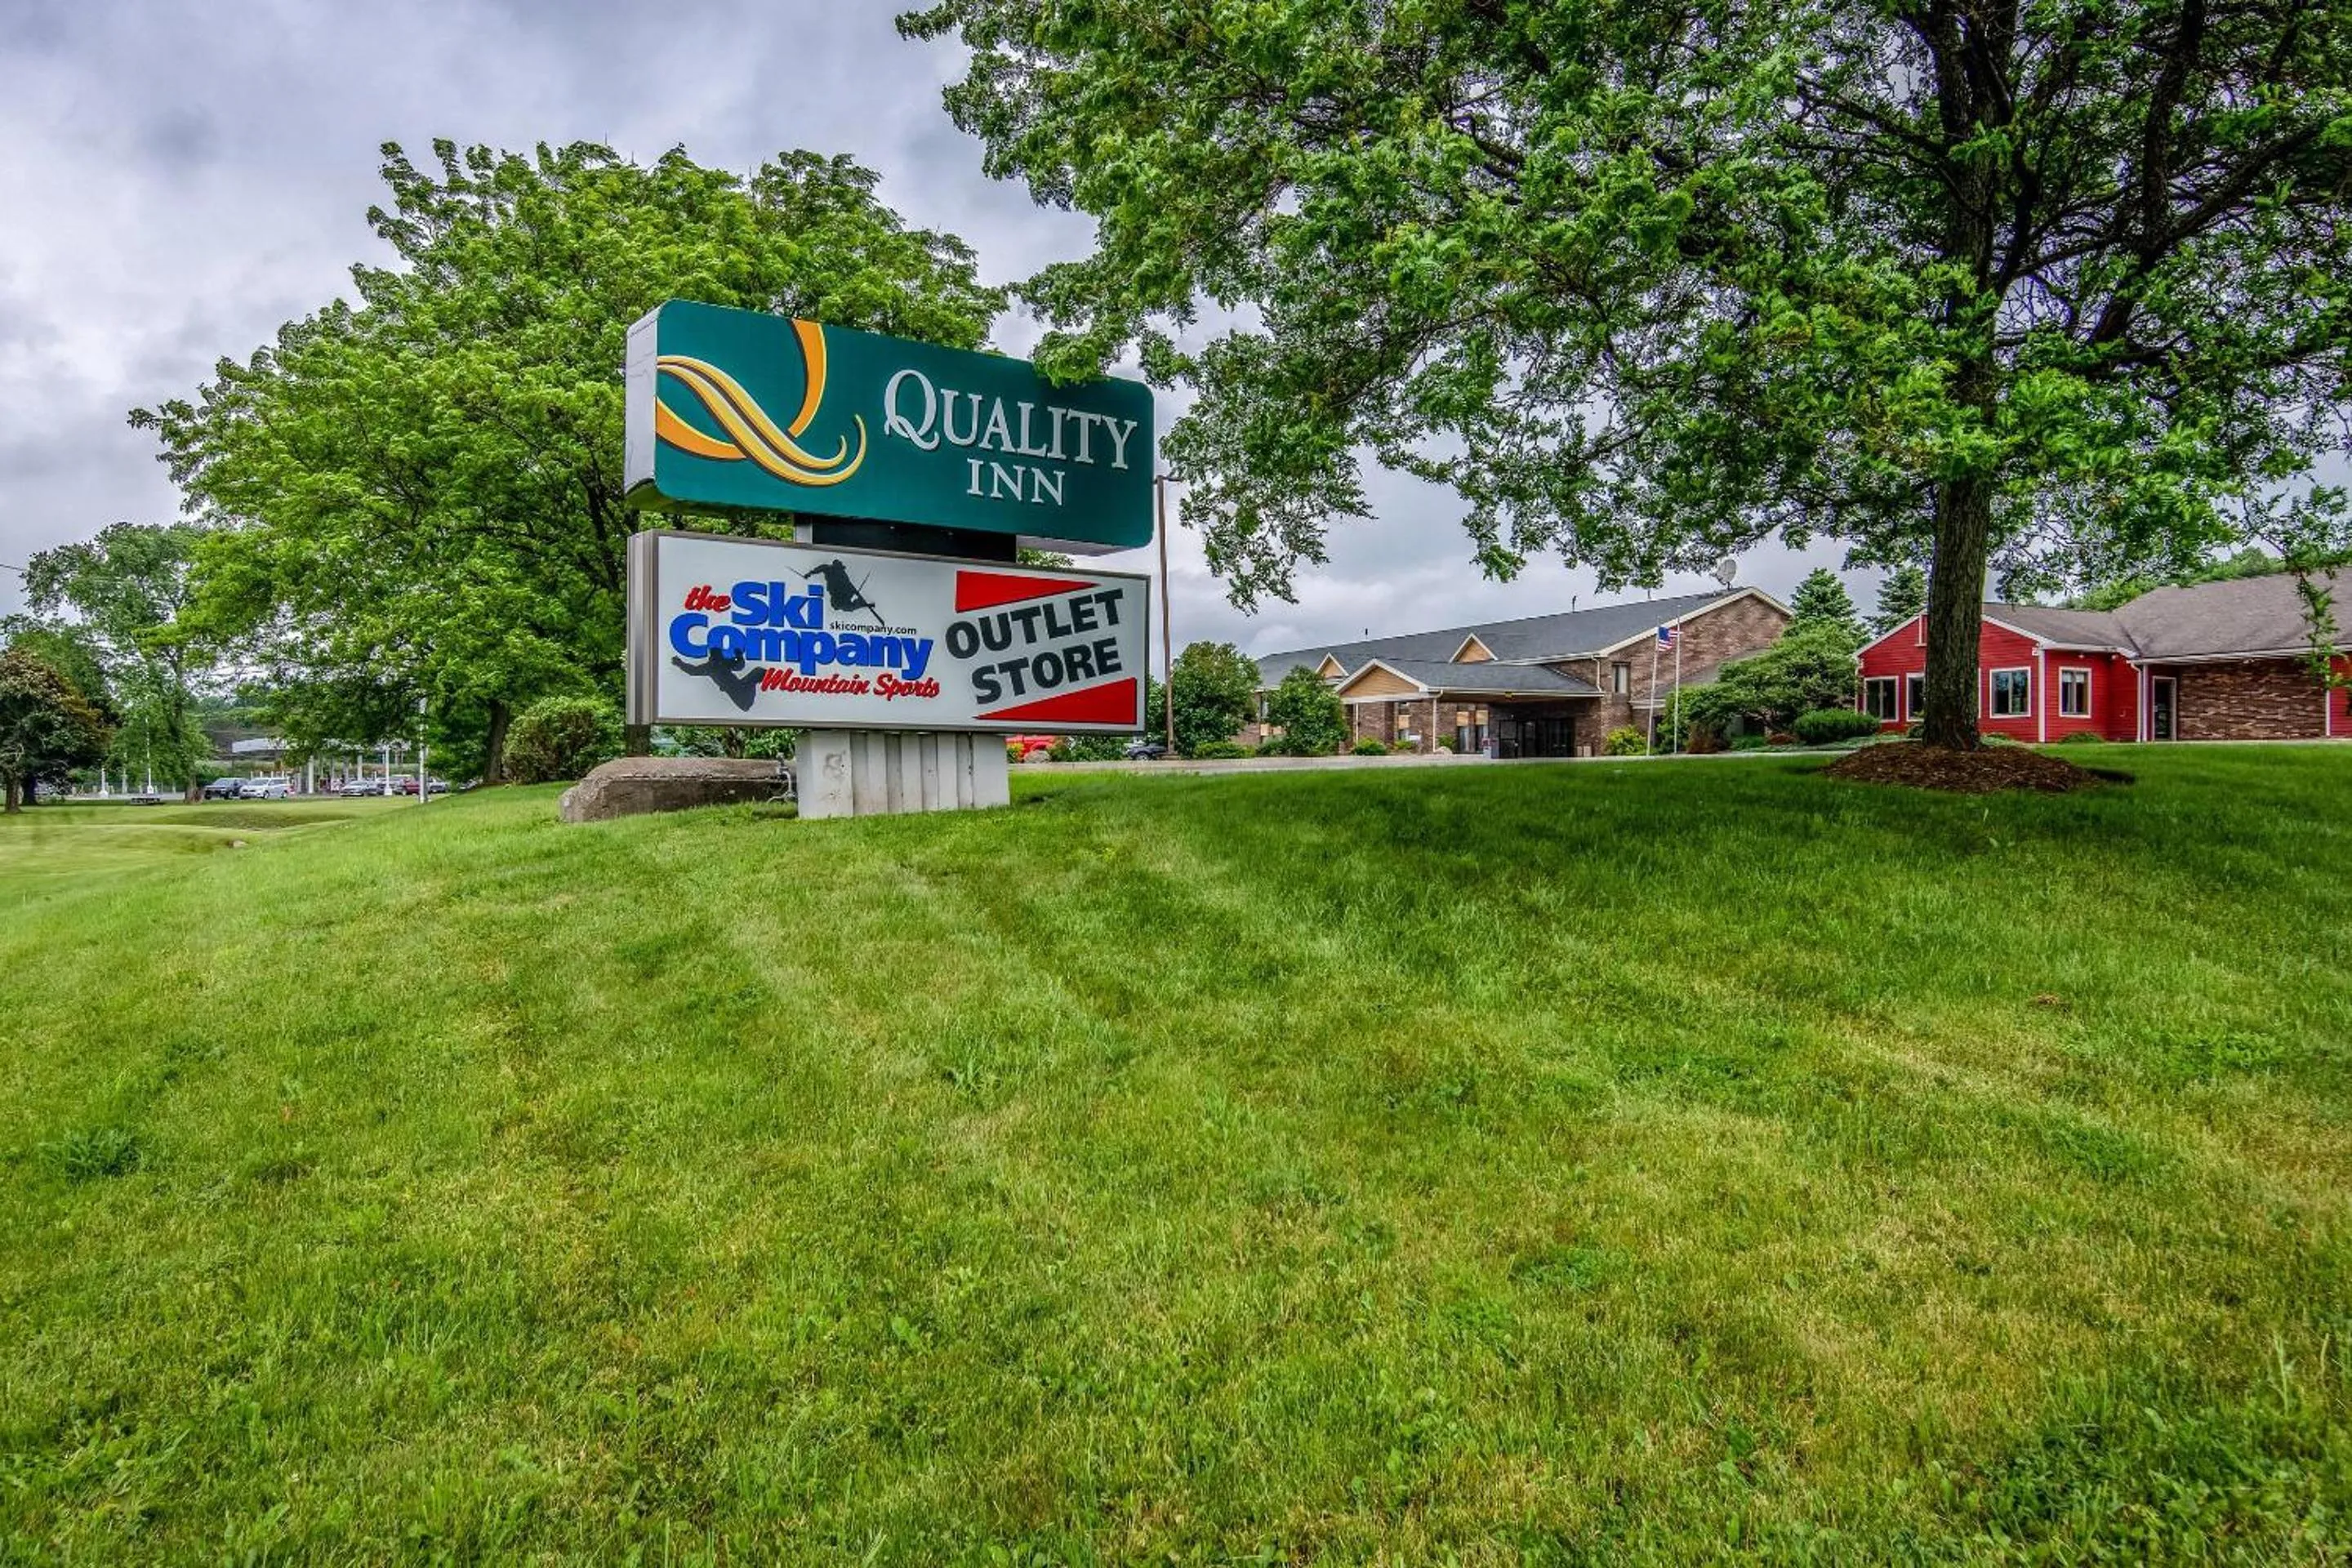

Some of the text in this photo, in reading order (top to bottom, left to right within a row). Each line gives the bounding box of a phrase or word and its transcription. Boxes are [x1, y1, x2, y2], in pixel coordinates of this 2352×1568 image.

[884, 369, 1137, 470] QUALITY
[967, 459, 1065, 505] INN
[684, 581, 824, 629] the Ski
[829, 621, 917, 635] skicompany.com
[946, 589, 1124, 658] OUTLET
[669, 612, 933, 680] Company
[973, 637, 1122, 705] STORE
[760, 667, 940, 700] Mountain Sports
